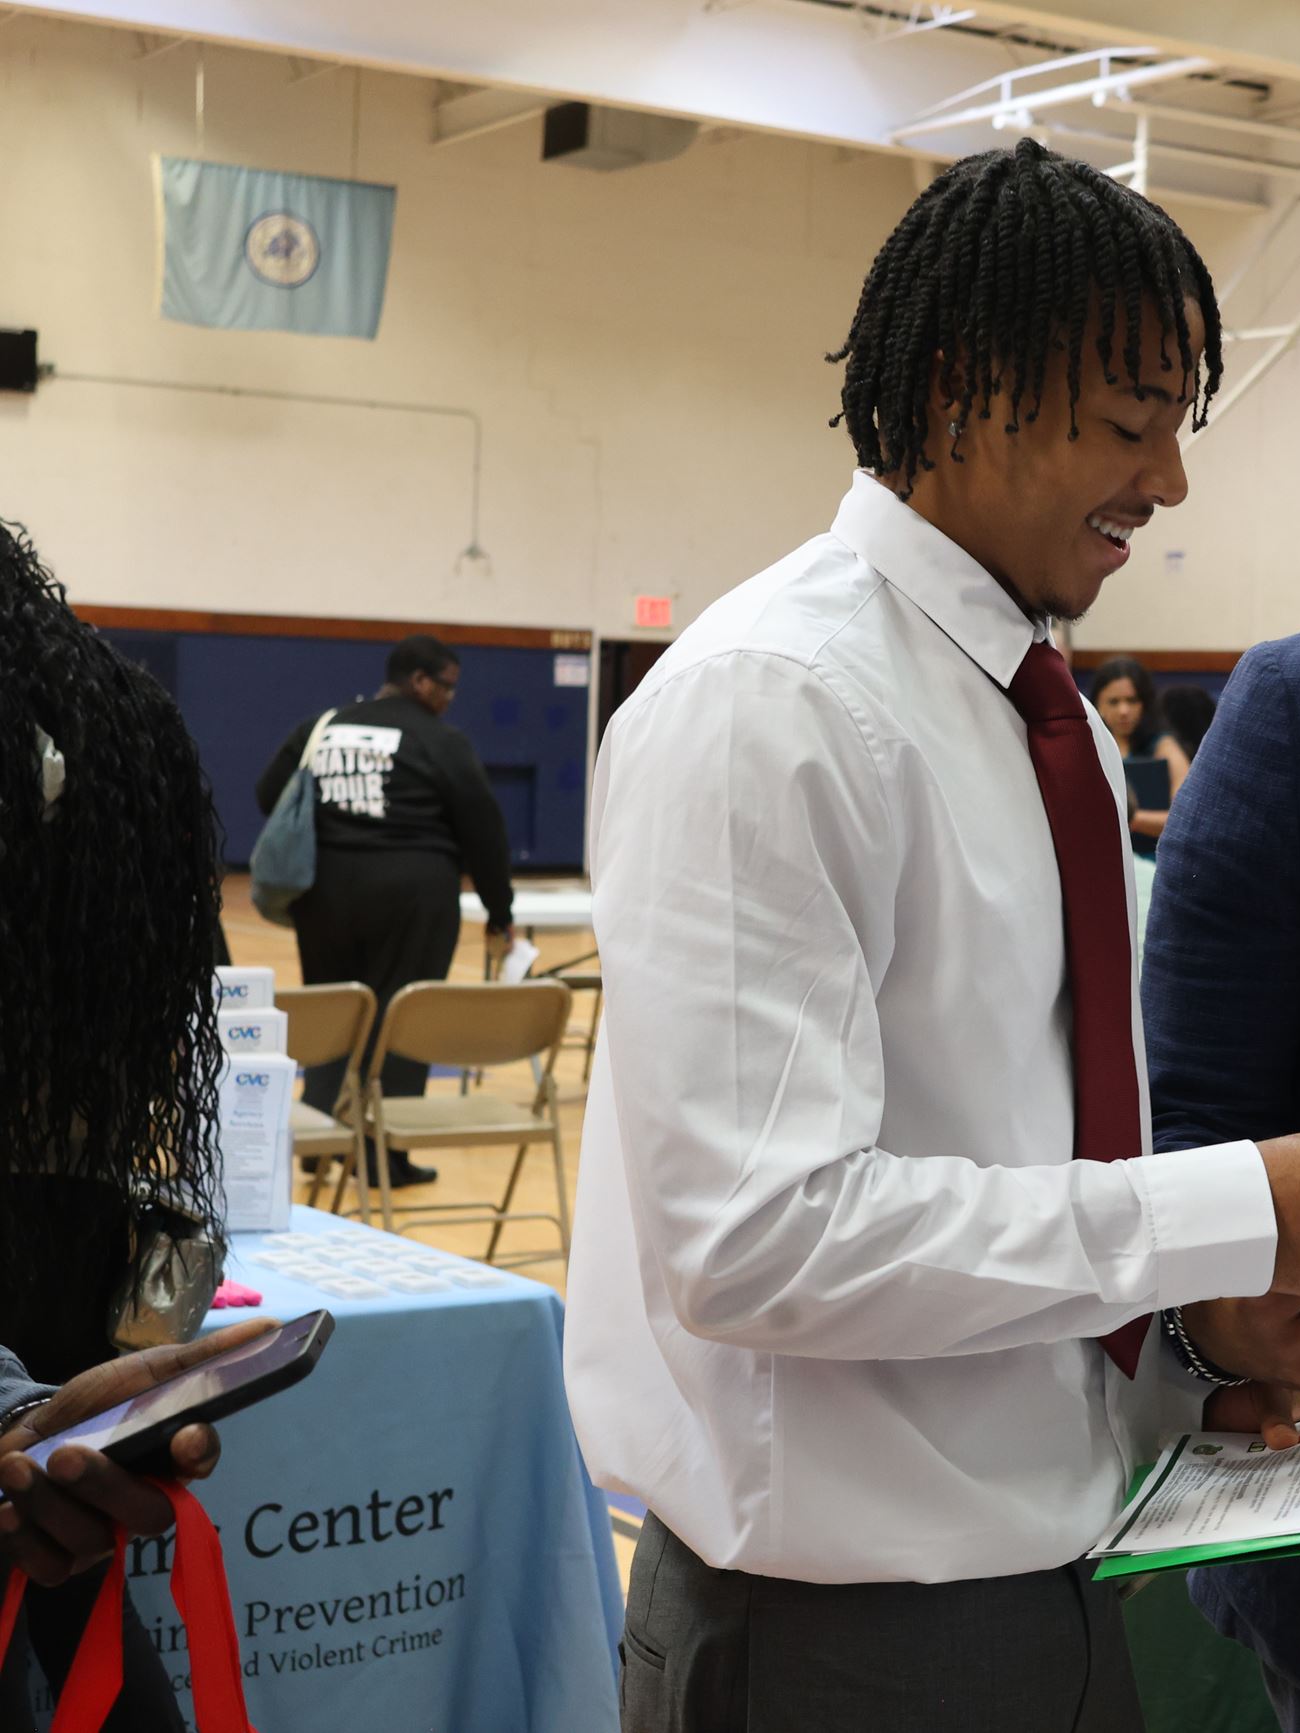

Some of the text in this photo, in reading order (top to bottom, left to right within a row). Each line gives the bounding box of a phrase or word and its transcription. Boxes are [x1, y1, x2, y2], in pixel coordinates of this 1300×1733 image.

[320, 774, 384, 803] YOUR
[216, 985, 248, 998] CVC
[228, 1026, 262, 1040] CVC
[236, 1073, 270, 1087] CVC
[244, 1487, 456, 1559] Center
[243, 1572, 466, 1638] Prevention
[269, 1641, 365, 1675] Violent
[372, 1627, 443, 1659] Crime
